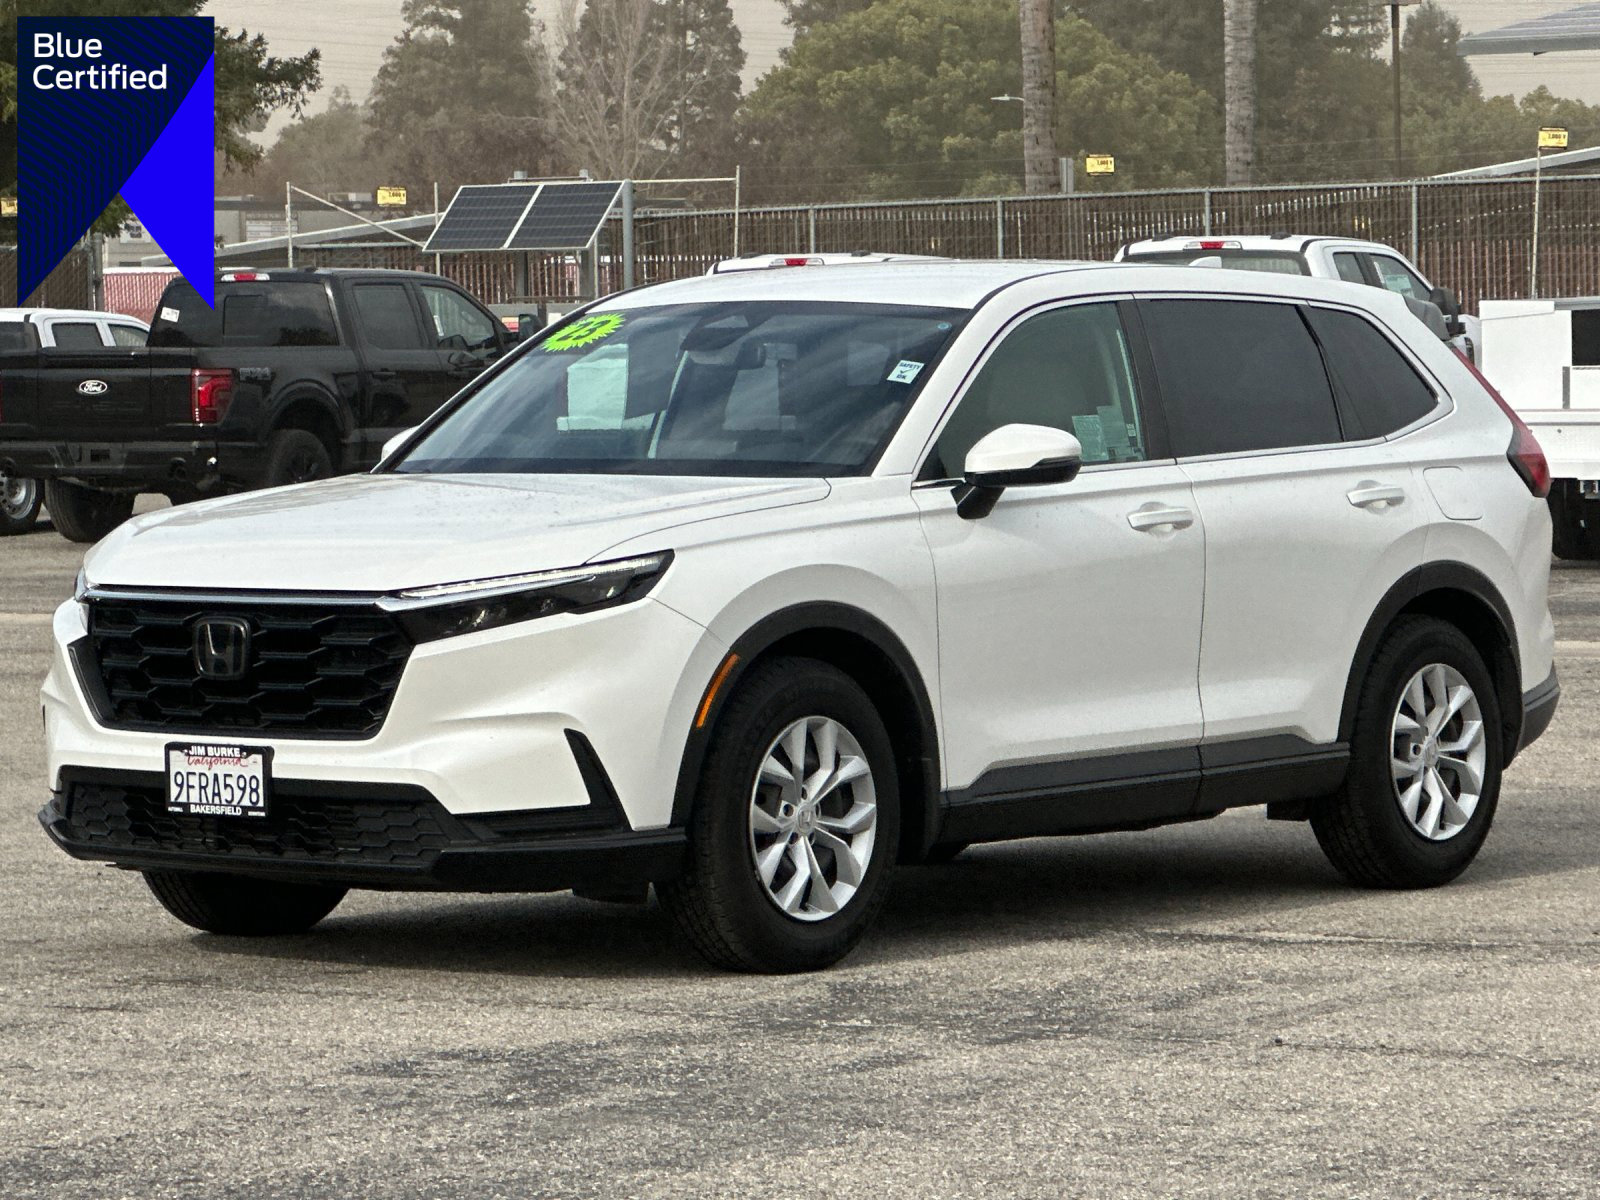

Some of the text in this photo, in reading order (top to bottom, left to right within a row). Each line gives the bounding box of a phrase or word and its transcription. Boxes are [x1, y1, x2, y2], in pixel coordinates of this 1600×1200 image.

[899, 362, 921, 370] SAFETY
[82, 382, 103, 393] Ford
[189, 745, 241, 758] JIM BURKE
[187, 756, 248, 771] California
[173, 771, 260, 806] 9FRA598
[190, 804, 242, 815] BAKERSFIELD
